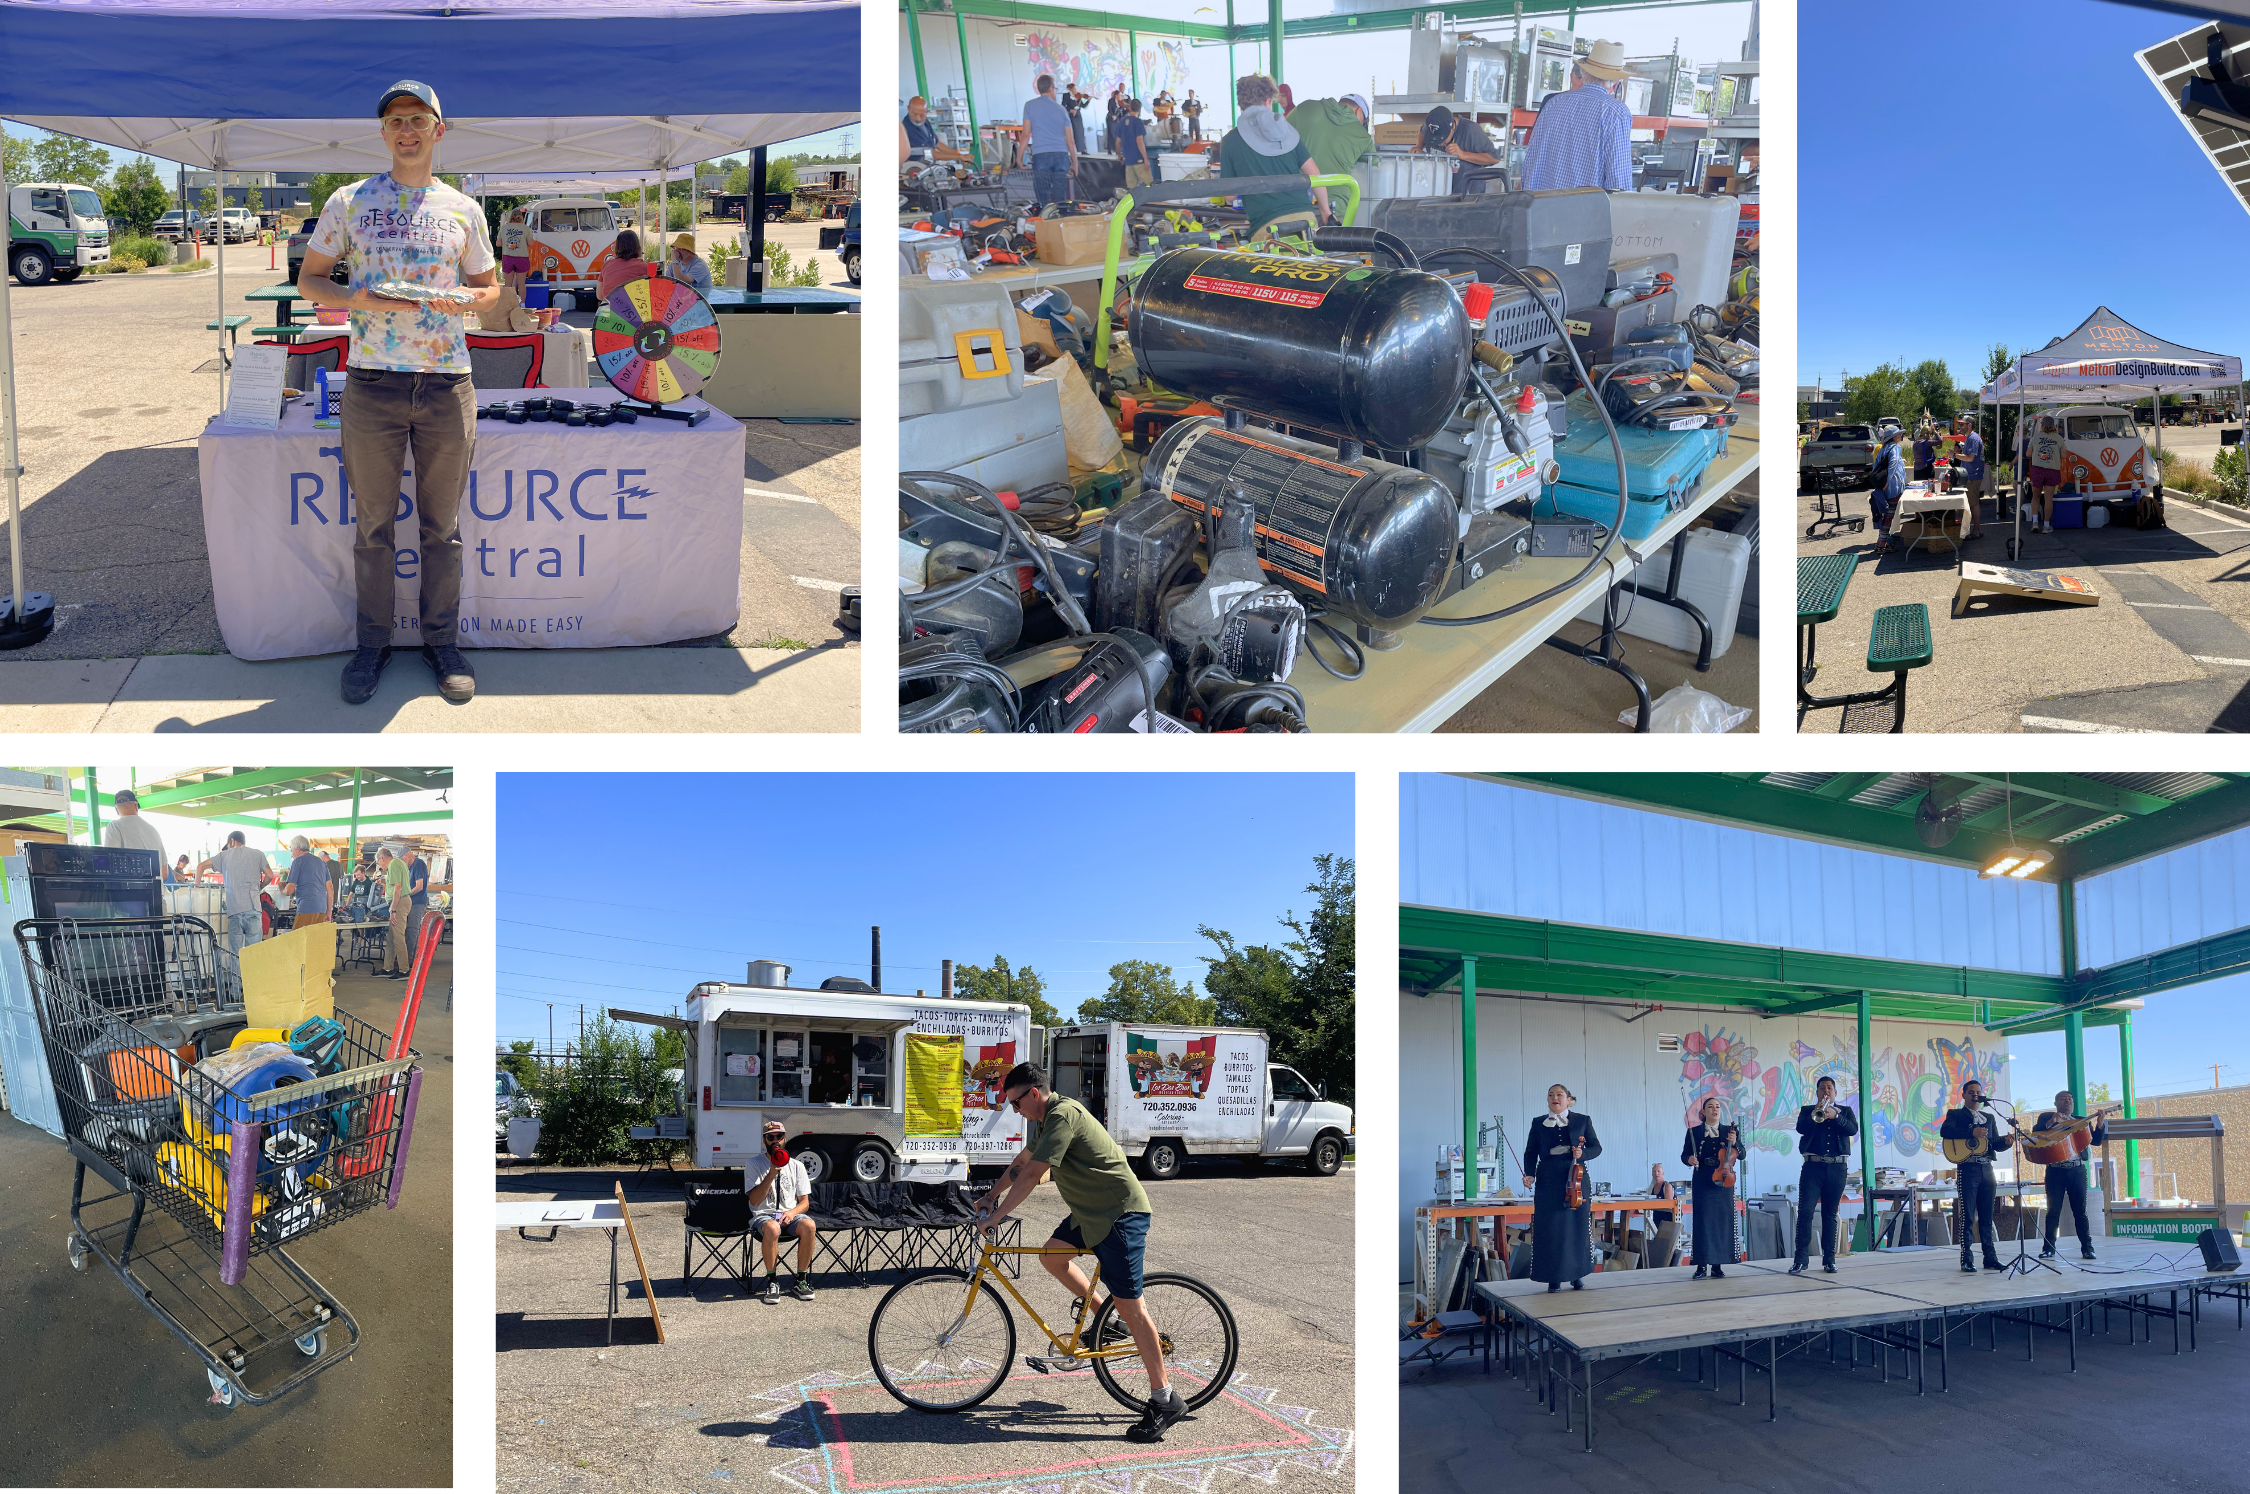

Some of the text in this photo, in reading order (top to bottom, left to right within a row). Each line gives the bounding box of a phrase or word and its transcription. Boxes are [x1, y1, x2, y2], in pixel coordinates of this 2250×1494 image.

[360, 208, 458, 234] RESOURCE
[377, 230, 445, 244] central
[1612, 235, 1664, 248] OTTOM
[1187, 278, 1197, 287] 5
[1251, 287, 1278, 299] 115V
[1279, 291, 1300, 303] 115
[2079, 362, 2201, 380] MeltonDesignBuild.com
[290, 447, 661, 526] RESURCE
[395, 534, 585, 579] etral
[490, 618, 538, 634] MADE
[546, 615, 584, 633] EASY
[914, 1009, 1012, 1025] TACOS TORTAS TAMALES
[916, 1023, 1009, 1037] ENCHILADAS BURRITOS
[1230, 1052, 1249, 1061] TACOS
[1224, 1063, 1253, 1072] BURRITOS
[1225, 1074, 1252, 1083] TAMALES
[1227, 1086, 1249, 1094] TORTAS
[1217, 1096, 1257, 1105] QUESADILLAS
[1142, 1102, 1197, 1112] 720.352.0936
[1218, 1107, 1255, 1116] ENCHILADAS
[905, 1141, 957, 1151] 720-352-0936
[2116, 1223, 2213, 1234] INFORMATION BOOTH
